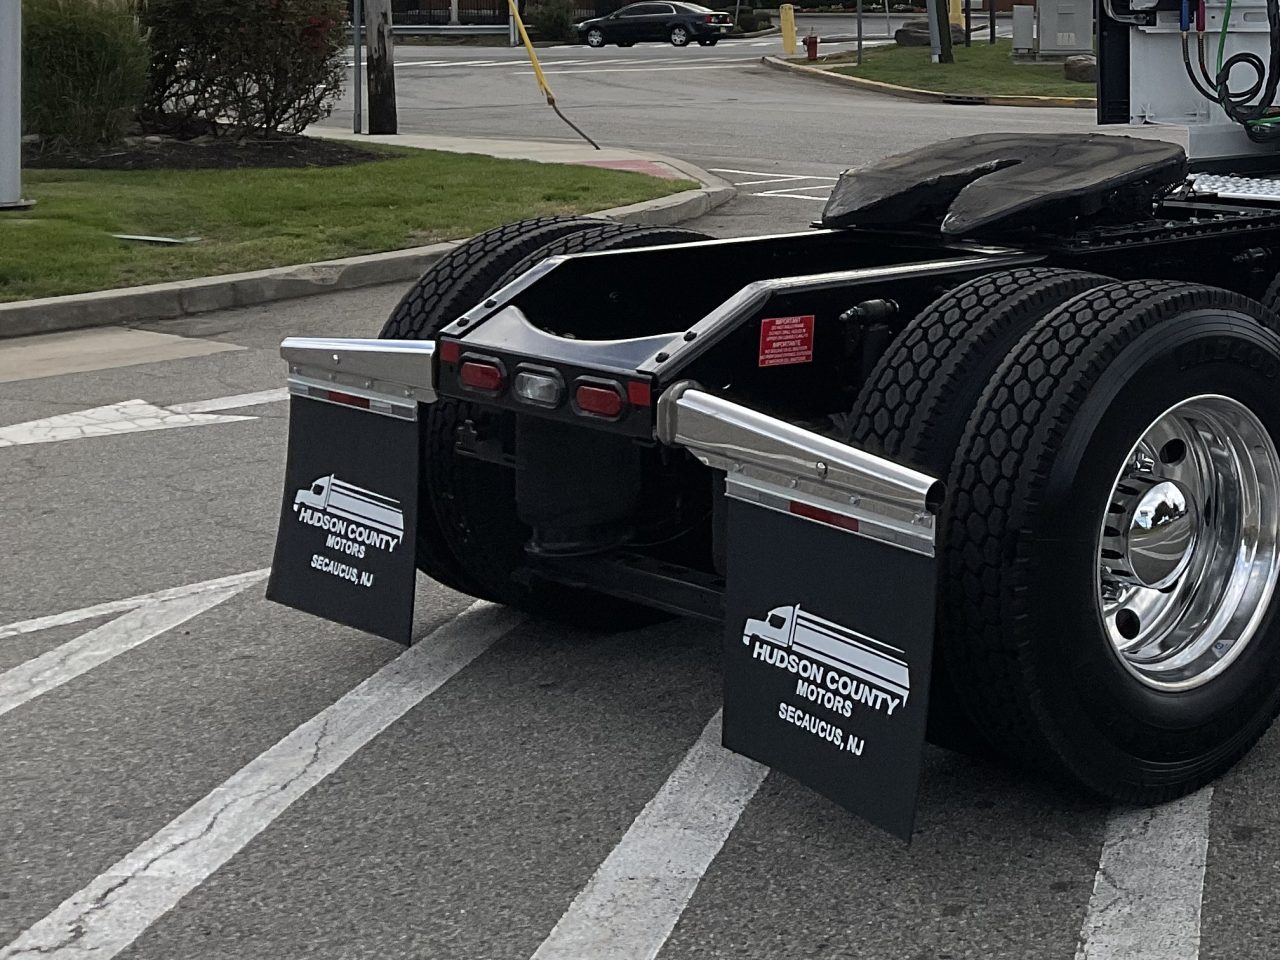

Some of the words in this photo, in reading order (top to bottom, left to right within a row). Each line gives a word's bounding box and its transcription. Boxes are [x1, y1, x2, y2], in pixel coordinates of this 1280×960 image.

[298, 507, 347, 535] HUDSON
[347, 524, 398, 553] COUNTY
[325, 533, 366, 559] MOTORS
[310, 554, 359, 585] SECAUCUS,
[360, 571, 374, 587] NJ
[752, 641, 825, 683] HUDSON
[826, 671, 900, 716] COUNTY
[796, 679, 853, 717] MOTORS
[778, 702, 845, 751] SECAUCUS,
[846, 734, 865, 757] NJ
